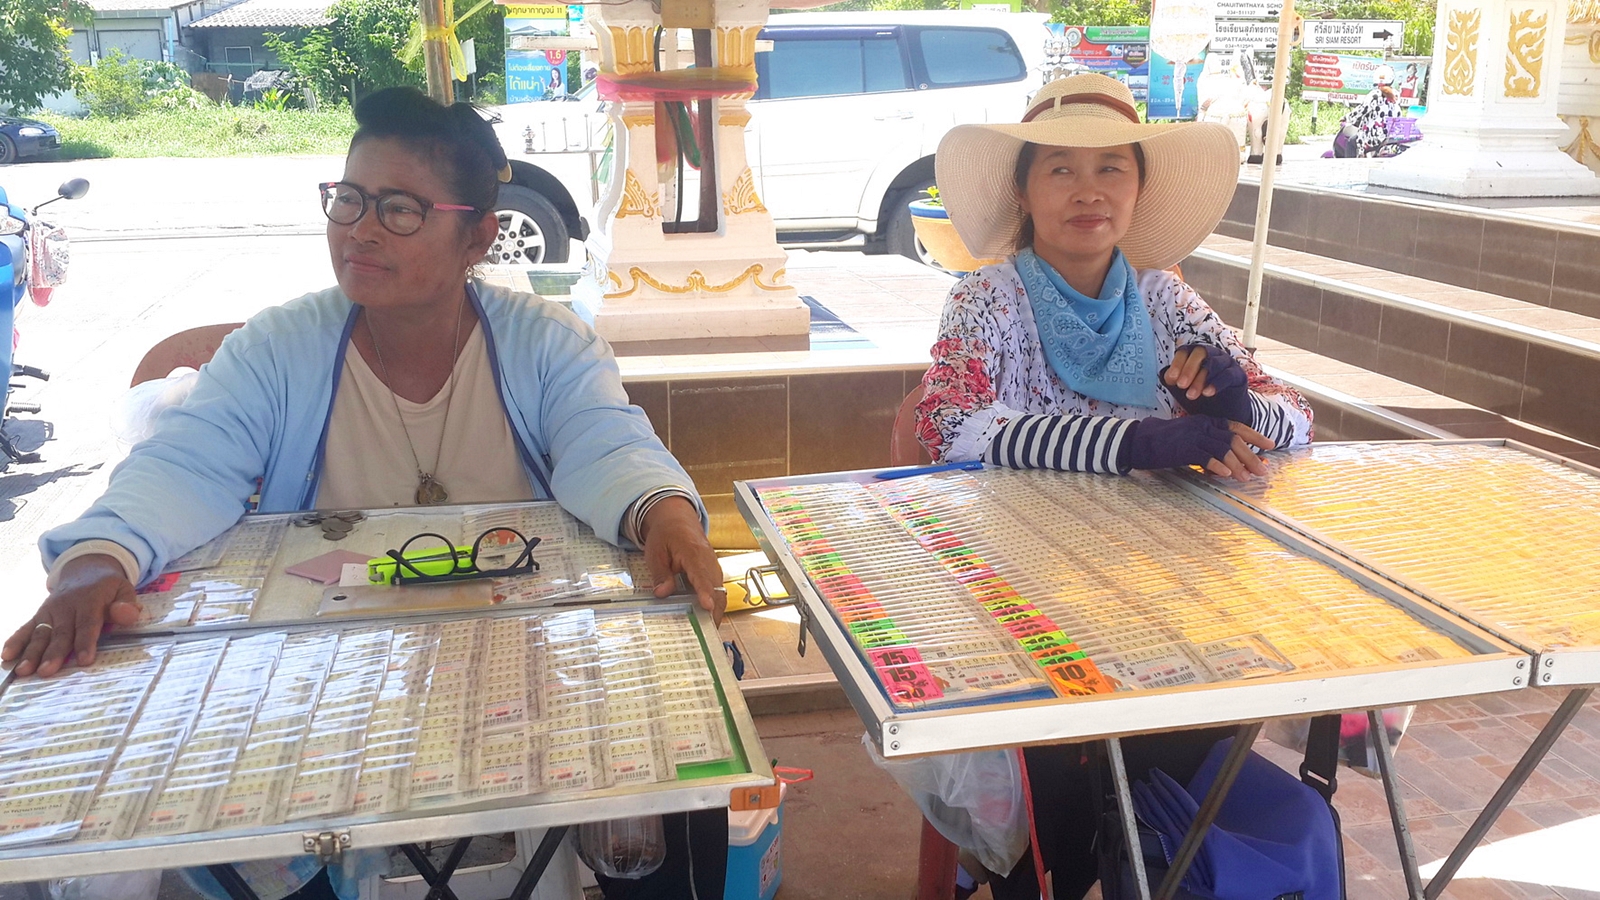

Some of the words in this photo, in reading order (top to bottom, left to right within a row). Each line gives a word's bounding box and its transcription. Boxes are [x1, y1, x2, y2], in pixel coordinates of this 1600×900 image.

[1315, 36, 1325, 44] SRI
[1326, 36, 1339, 44] SIAM
[1340, 36, 1362, 44] RESORT
[549, 50, 561, 60] 1.6
[885, 666, 917, 683] 15
[1052, 664, 1086, 681] 10
